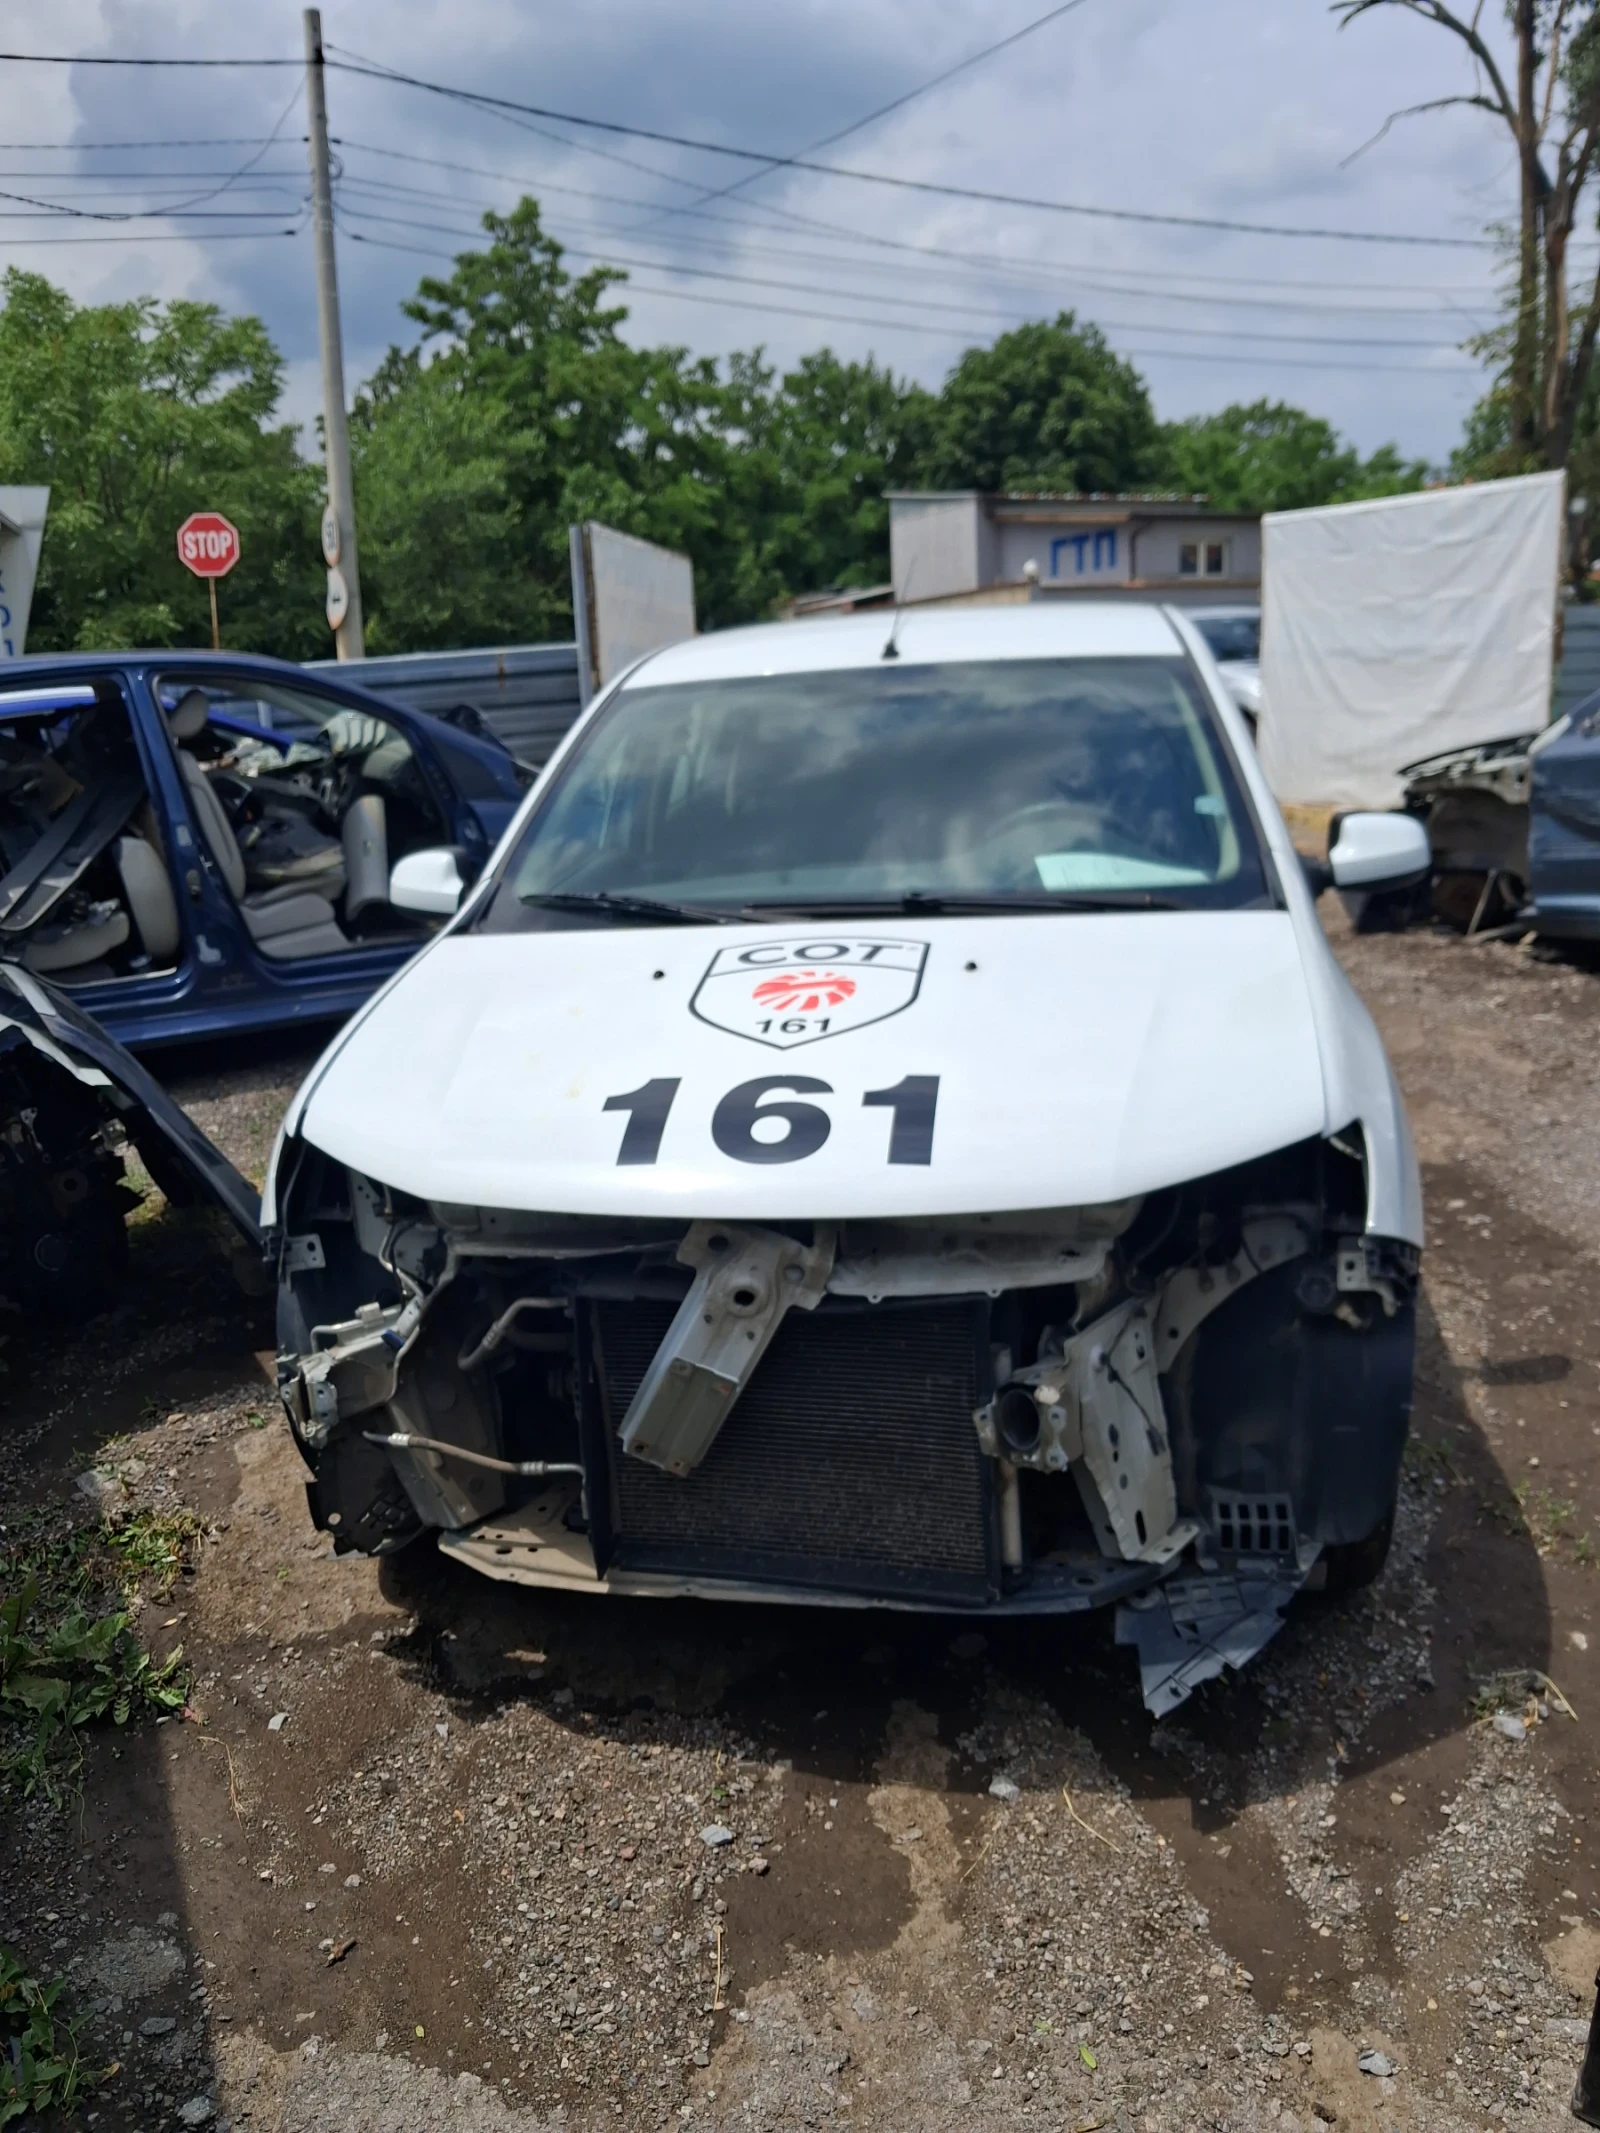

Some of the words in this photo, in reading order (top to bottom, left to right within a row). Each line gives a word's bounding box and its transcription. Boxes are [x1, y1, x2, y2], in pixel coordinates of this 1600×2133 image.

[183, 530, 232, 559] STOP
[1050, 528, 1117, 577] ГТП
[755, 1017, 832, 1034] 161
[601, 1074, 940, 1166] 161
